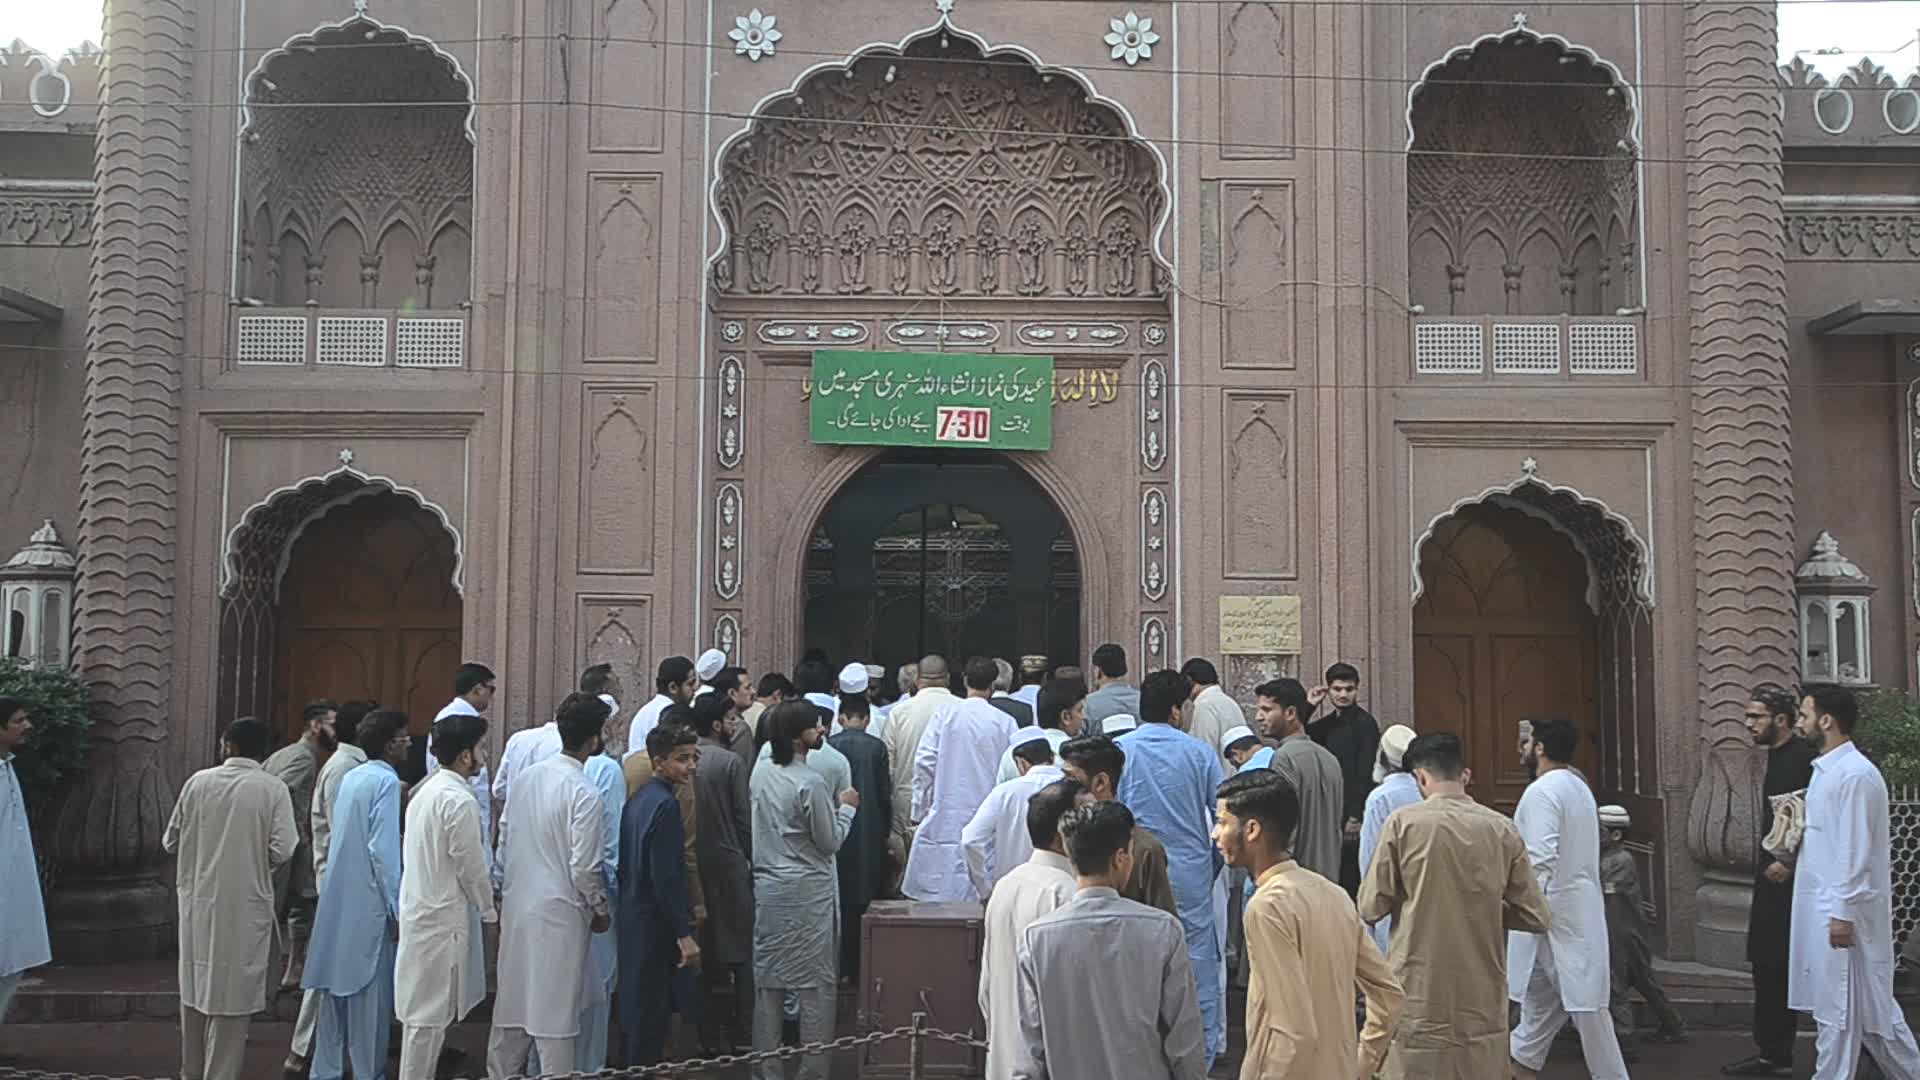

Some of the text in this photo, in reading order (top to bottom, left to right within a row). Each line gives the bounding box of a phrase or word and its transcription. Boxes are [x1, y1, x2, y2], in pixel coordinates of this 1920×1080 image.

[818, 367, 846, 396] میں
[845, 369, 880, 399] مسجد
[875, 370, 920, 401] سنہری
[976, 373, 1005, 397] نماز
[1018, 377, 1046, 402] عید
[849, 411, 881, 431] جائے
[881, 406, 899, 430] کی
[910, 412, 931, 432] بجے
[1000, 415, 1031, 434] بوقت
